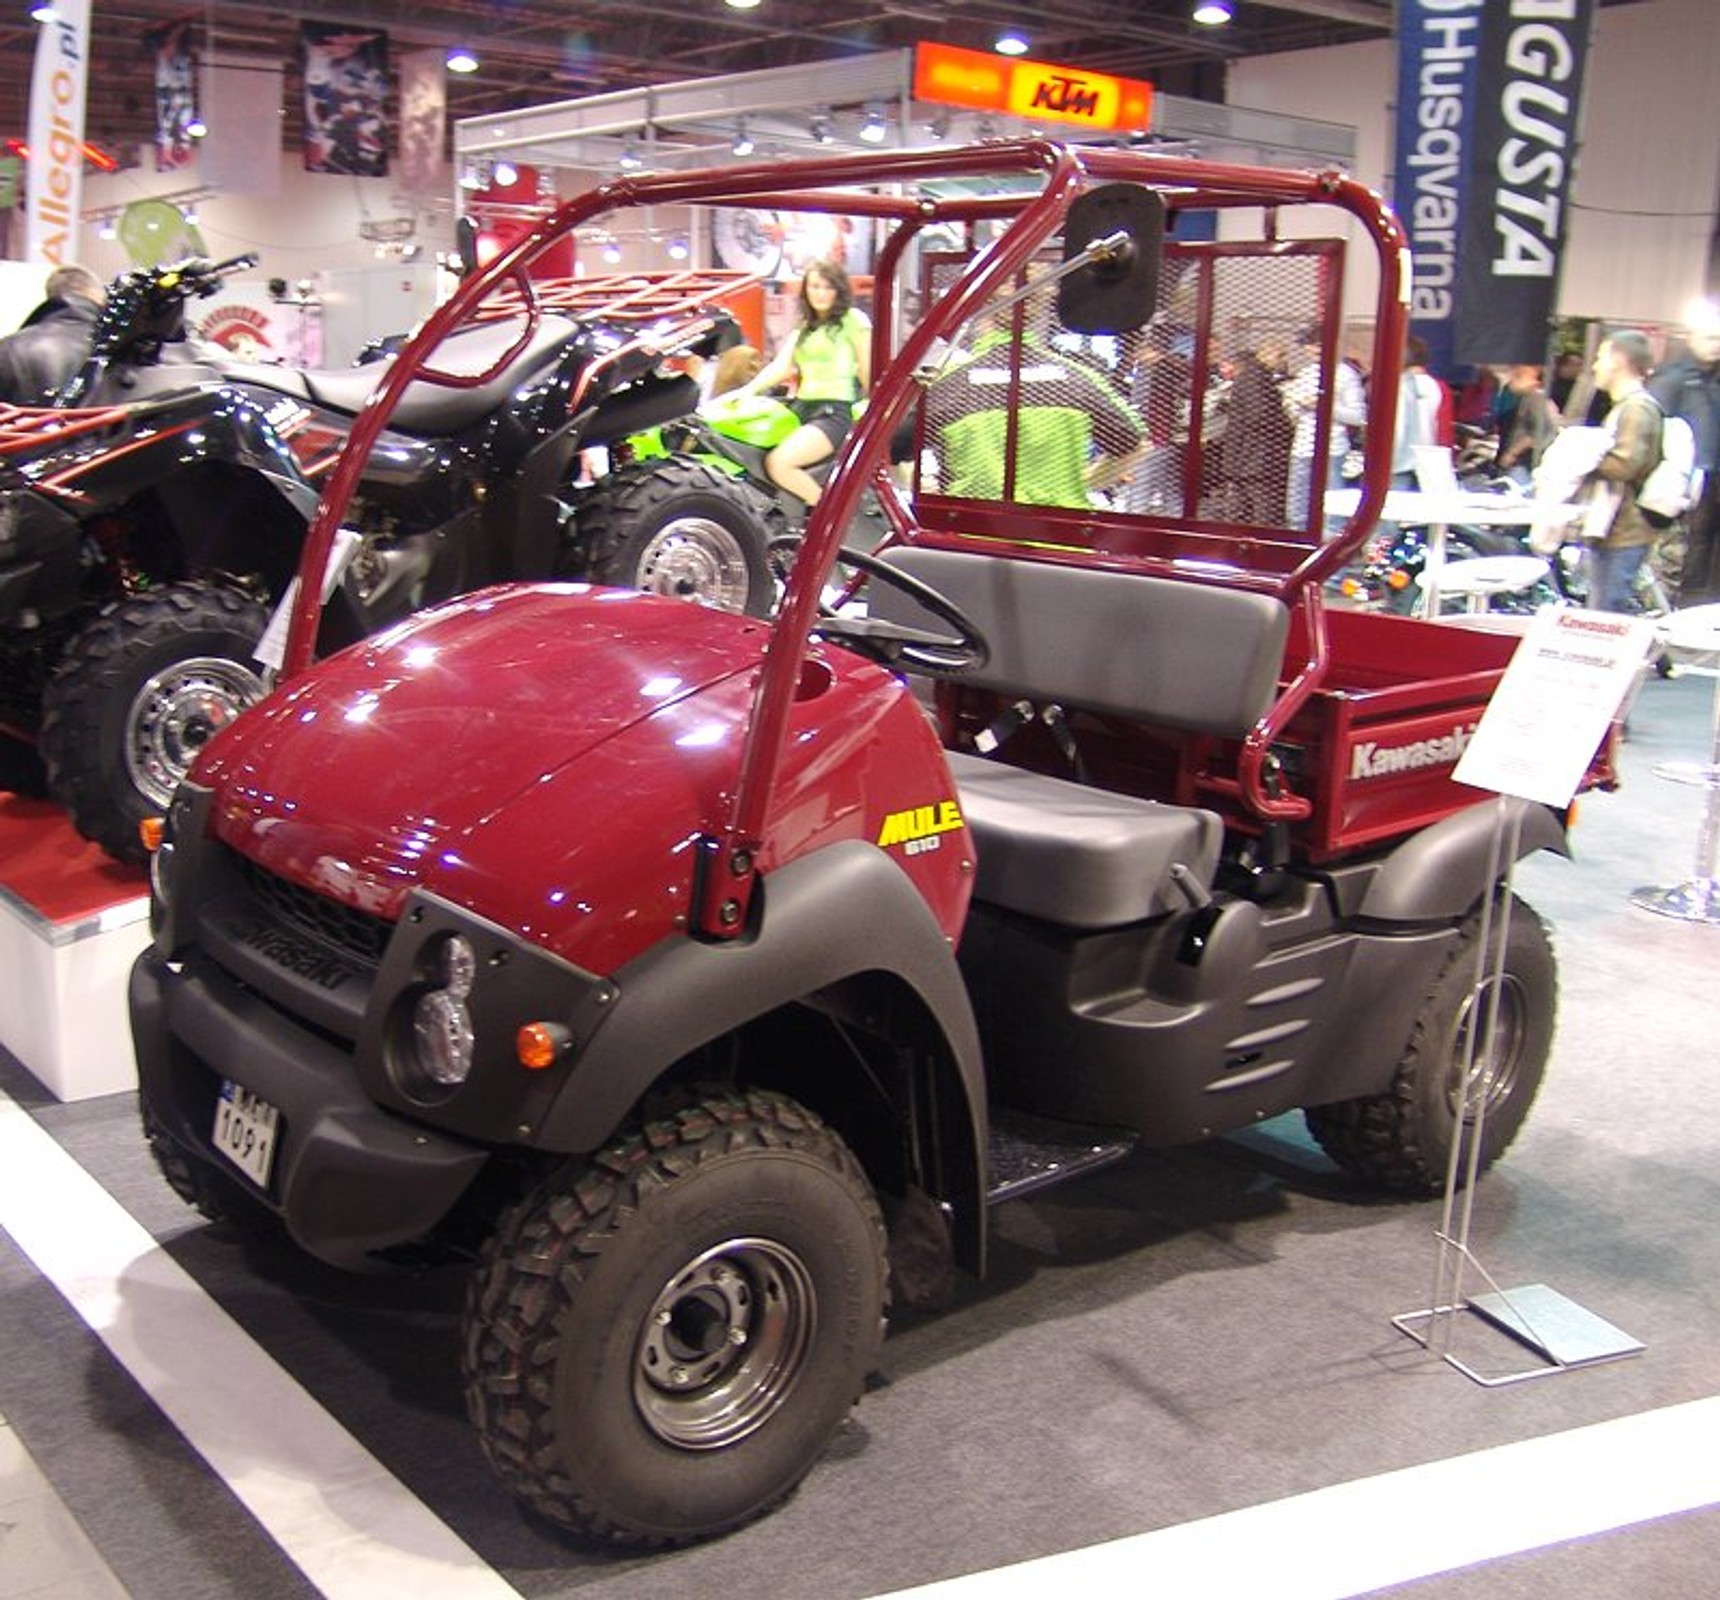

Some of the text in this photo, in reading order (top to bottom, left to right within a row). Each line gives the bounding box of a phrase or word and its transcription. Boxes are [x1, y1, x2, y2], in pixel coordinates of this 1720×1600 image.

[1030, 75, 1100, 117] KTM
[39, 20, 80, 267] Allegro.pl
[1406, 15, 1479, 320] Husqvarna
[1351, 722, 1478, 779] Kawasak
[876, 799, 965, 848] MULE
[221, 1108, 267, 1174] 1091
